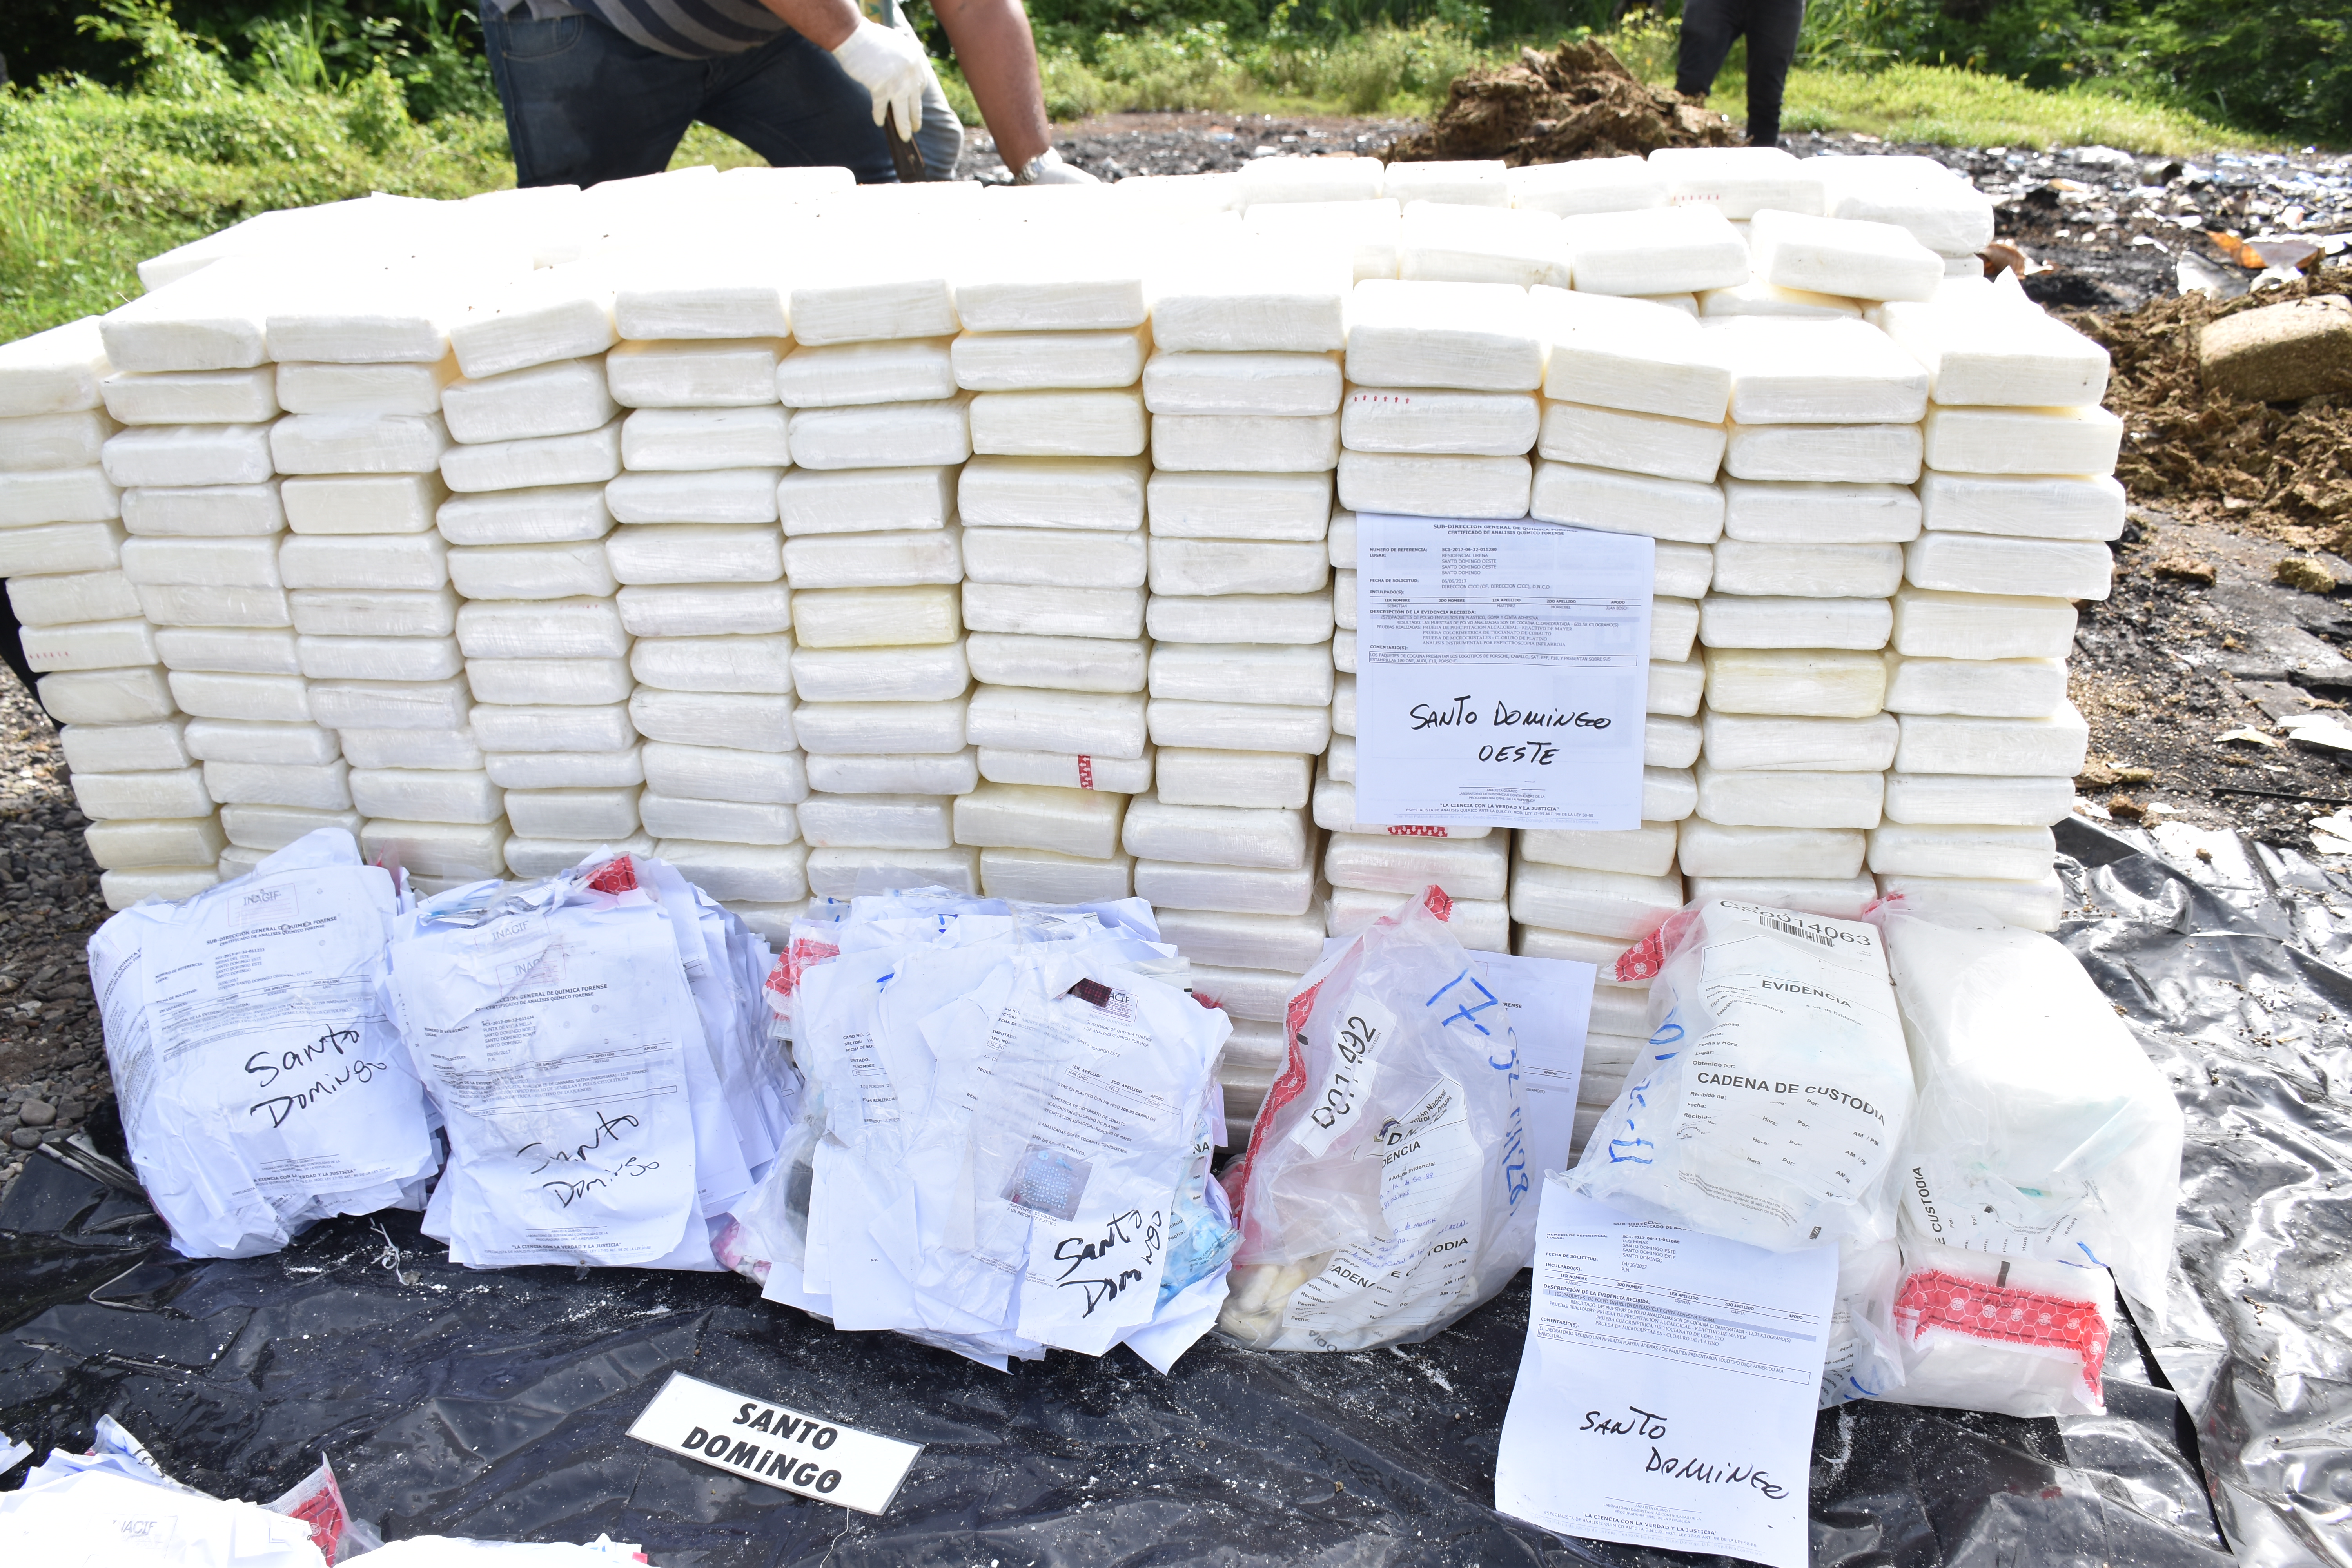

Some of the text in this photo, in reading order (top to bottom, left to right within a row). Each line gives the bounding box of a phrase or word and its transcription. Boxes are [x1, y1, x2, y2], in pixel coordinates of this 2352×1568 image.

[1410, 695, 1477, 730] SANTO
[1478, 741, 1560, 765] OESTE
[492, 921, 529, 941] INACIF
[1762, 980, 1852, 1008] EVIDENCIA
[1068, 1071, 1088, 1081] MARTINEZ
[1082, 1069, 1103, 1079] APELLIDO
[1121, 1084, 1142, 1093] APELLIDO
[250, 1060, 387, 1129] Domingo
[1426, 1088, 1447, 1111] Nacional
[1697, 1073, 1884, 1127] CADENA DE CUSTODIA
[1807, 1098, 1819, 1107] Por:
[1762, 1116, 1777, 1126] Hora:
[1797, 1120, 1810, 1129] Por:
[1752, 1137, 1769, 1145] Hora:
[1870, 1138, 1879, 1146] PM
[1747, 1156, 1762, 1166] Hora:
[1782, 1158, 1795, 1166] Por:
[1408, 1162, 1436, 1174] Evidencia:
[1912, 1167, 1942, 1233] CUSTODIA
[1041, 1214, 1057, 1222] COCAINA
[1545, 1263, 1582, 1272] INCULPADO(S):
[1544, 1283, 1580, 1293] DESCRIPCIÓN
[1598, 1292, 1625, 1300] EVIDENCIA
[1541, 1317, 1579, 1328] COMENTARIO(S):
[732, 1403, 838, 1450] SANTO
[1579, 1406, 1667, 1440] SANTO
[681, 1426, 842, 1494] DOMINGO
